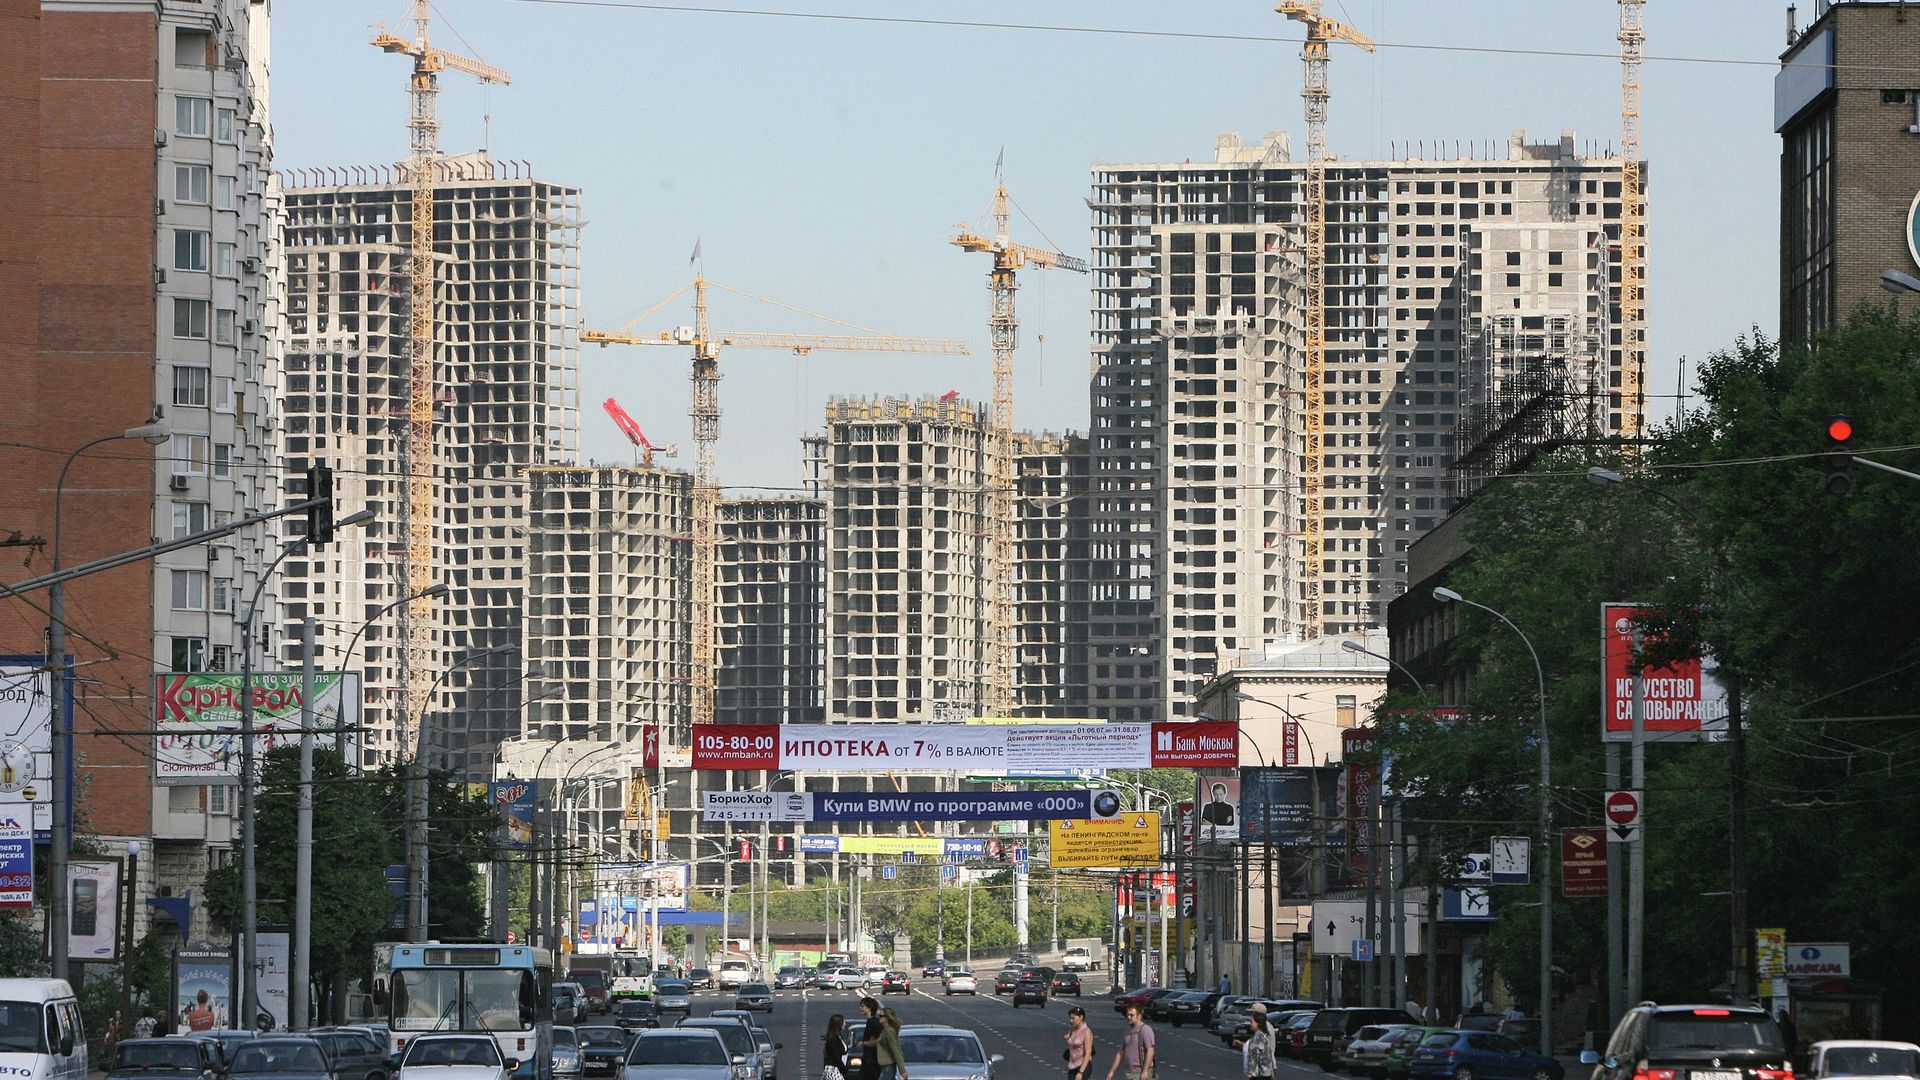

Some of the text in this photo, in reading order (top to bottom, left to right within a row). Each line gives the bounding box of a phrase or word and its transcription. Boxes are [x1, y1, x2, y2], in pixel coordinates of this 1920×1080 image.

[281, 675, 292, 683] 31
[295, 675, 329, 683] ИЛЯ
[1616, 678, 1694, 698] ИСУССТВО
[201, 711, 261, 720] СЕМЕРК
[1616, 700, 1729, 720] САОВЫРАЖЕН
[698, 735, 774, 750] 105-80-00
[785, 740, 890, 757] ИПОТЕКА
[956, 746, 1004, 757] ВАЛЮТЕ
[1176, 736, 1196, 751] Банк
[1199, 735, 1233, 751] Москвы
[1286, 724, 1295, 763] 995 22 25
[1346, 739, 1377, 754] КАФ
[697, 751, 774, 759] www.mmbank.ru
[1203, 752, 1236, 760] ДОВЕРЯТЬ
[709, 794, 773, 805] БорисХоф
[824, 799, 864, 814] Купи
[868, 799, 911, 813] BMW
[914, 801, 933, 812] по
[938, 801, 1033, 815] программе
[710, 811, 773, 820] 745-1111
[946, 842, 982, 852] 730-10-10
